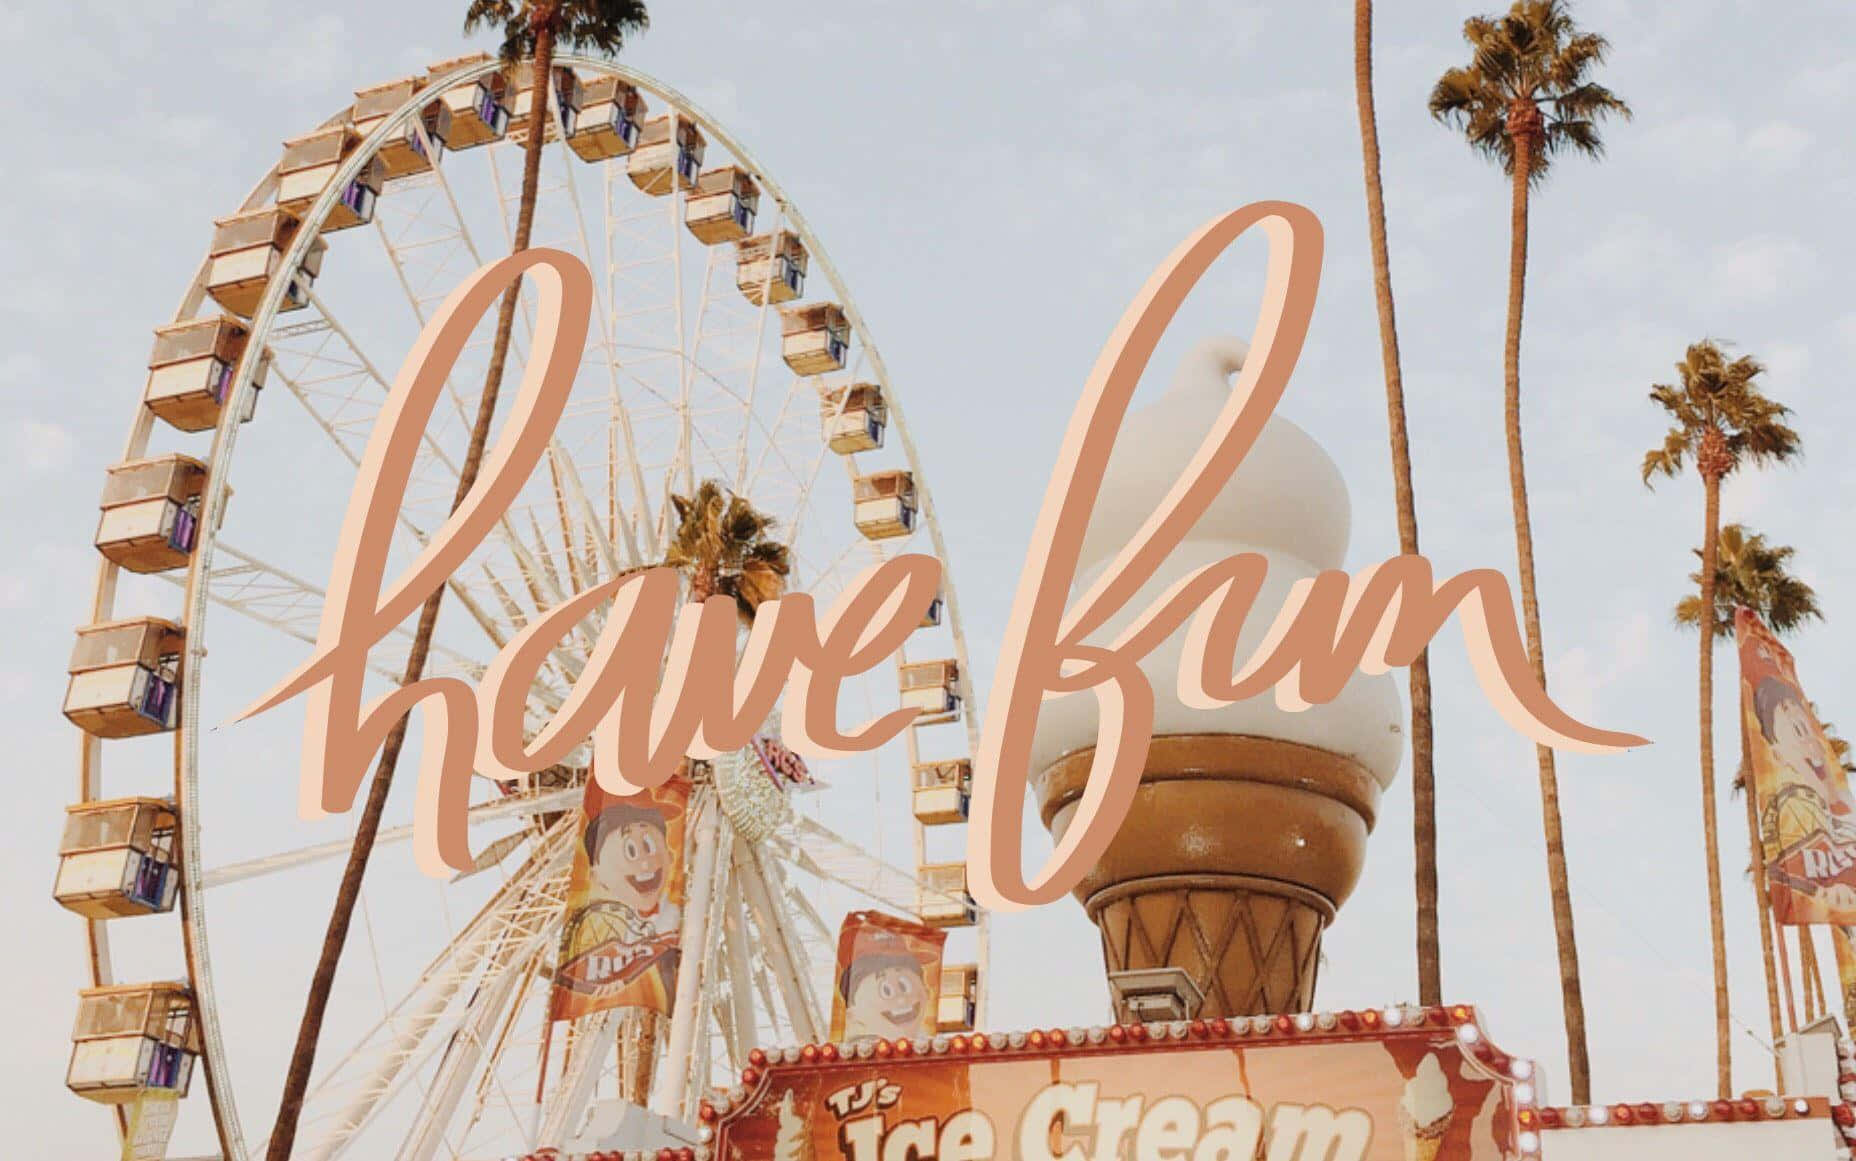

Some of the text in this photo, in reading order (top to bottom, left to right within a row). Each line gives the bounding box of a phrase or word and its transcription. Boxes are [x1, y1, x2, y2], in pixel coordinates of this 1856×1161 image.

[827, 1077, 902, 1119] TJ's
[838, 1080, 1374, 1161] Ice Cream
